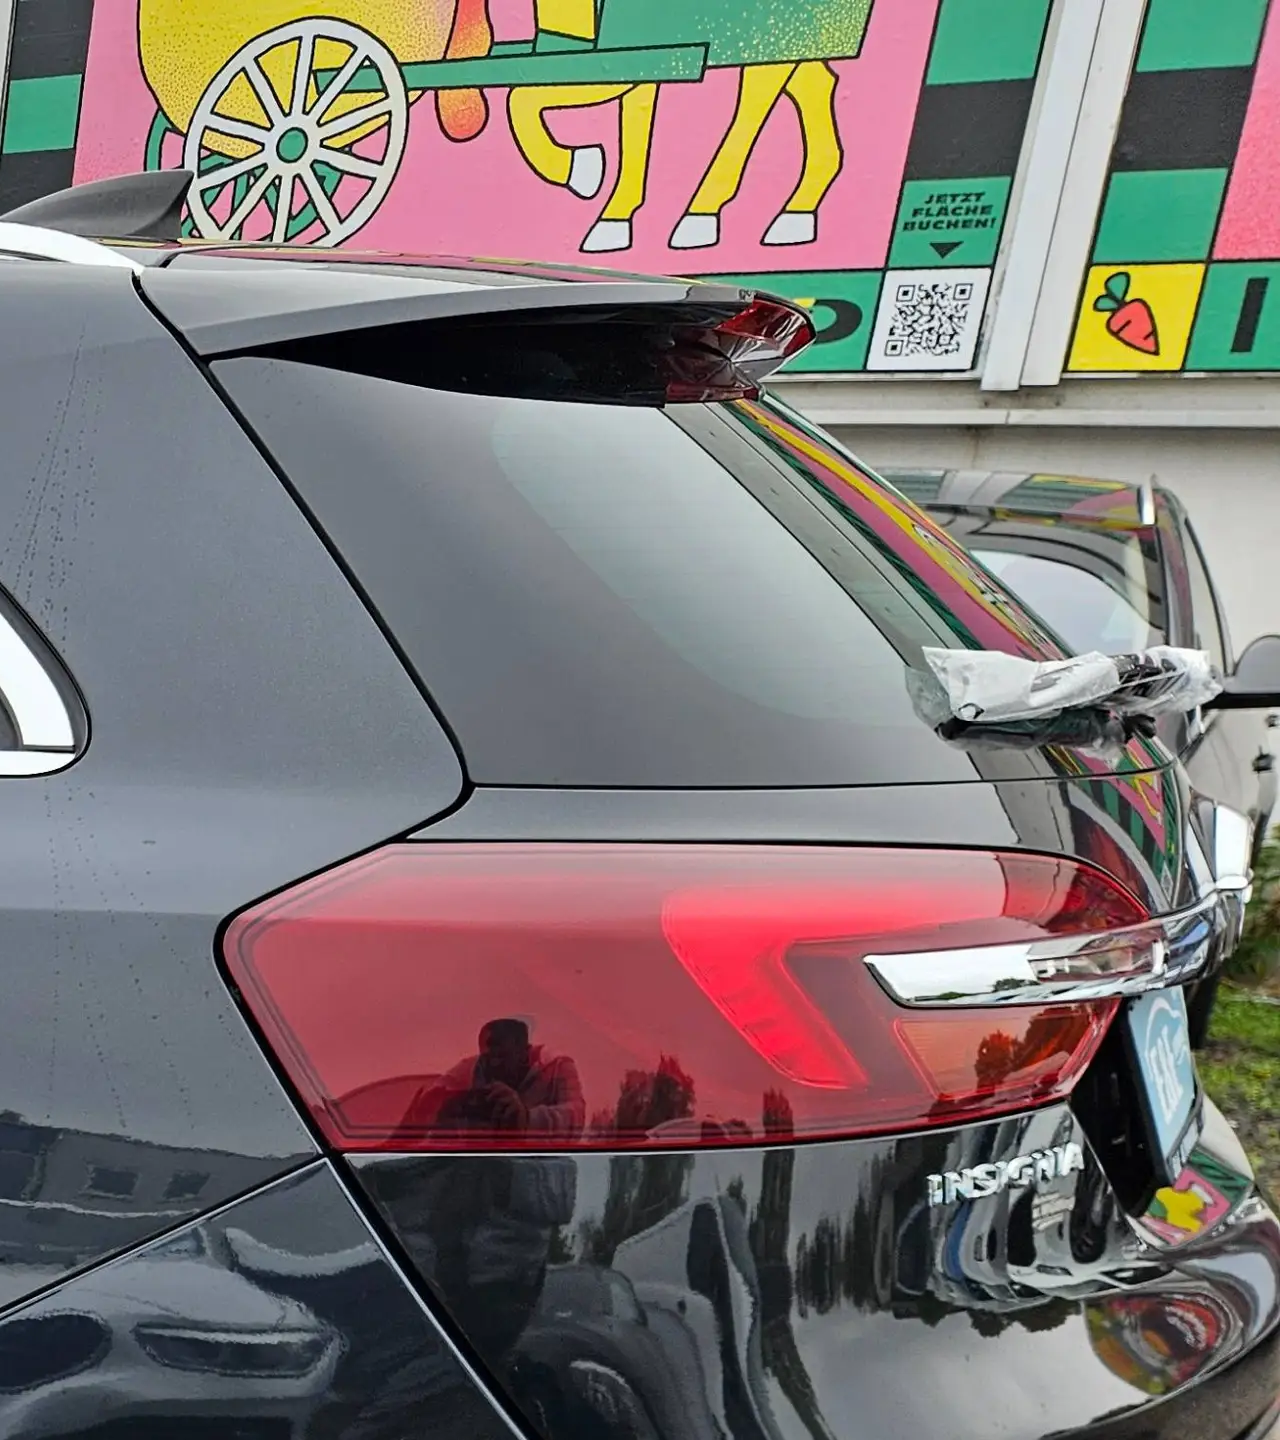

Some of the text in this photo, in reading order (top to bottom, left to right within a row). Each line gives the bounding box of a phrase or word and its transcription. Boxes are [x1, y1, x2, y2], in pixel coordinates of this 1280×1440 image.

[924, 191, 986, 204] JETZT
[902, 217, 997, 231] BUCHEN!
[926, 1141, 1085, 1207] INSIGNIA
